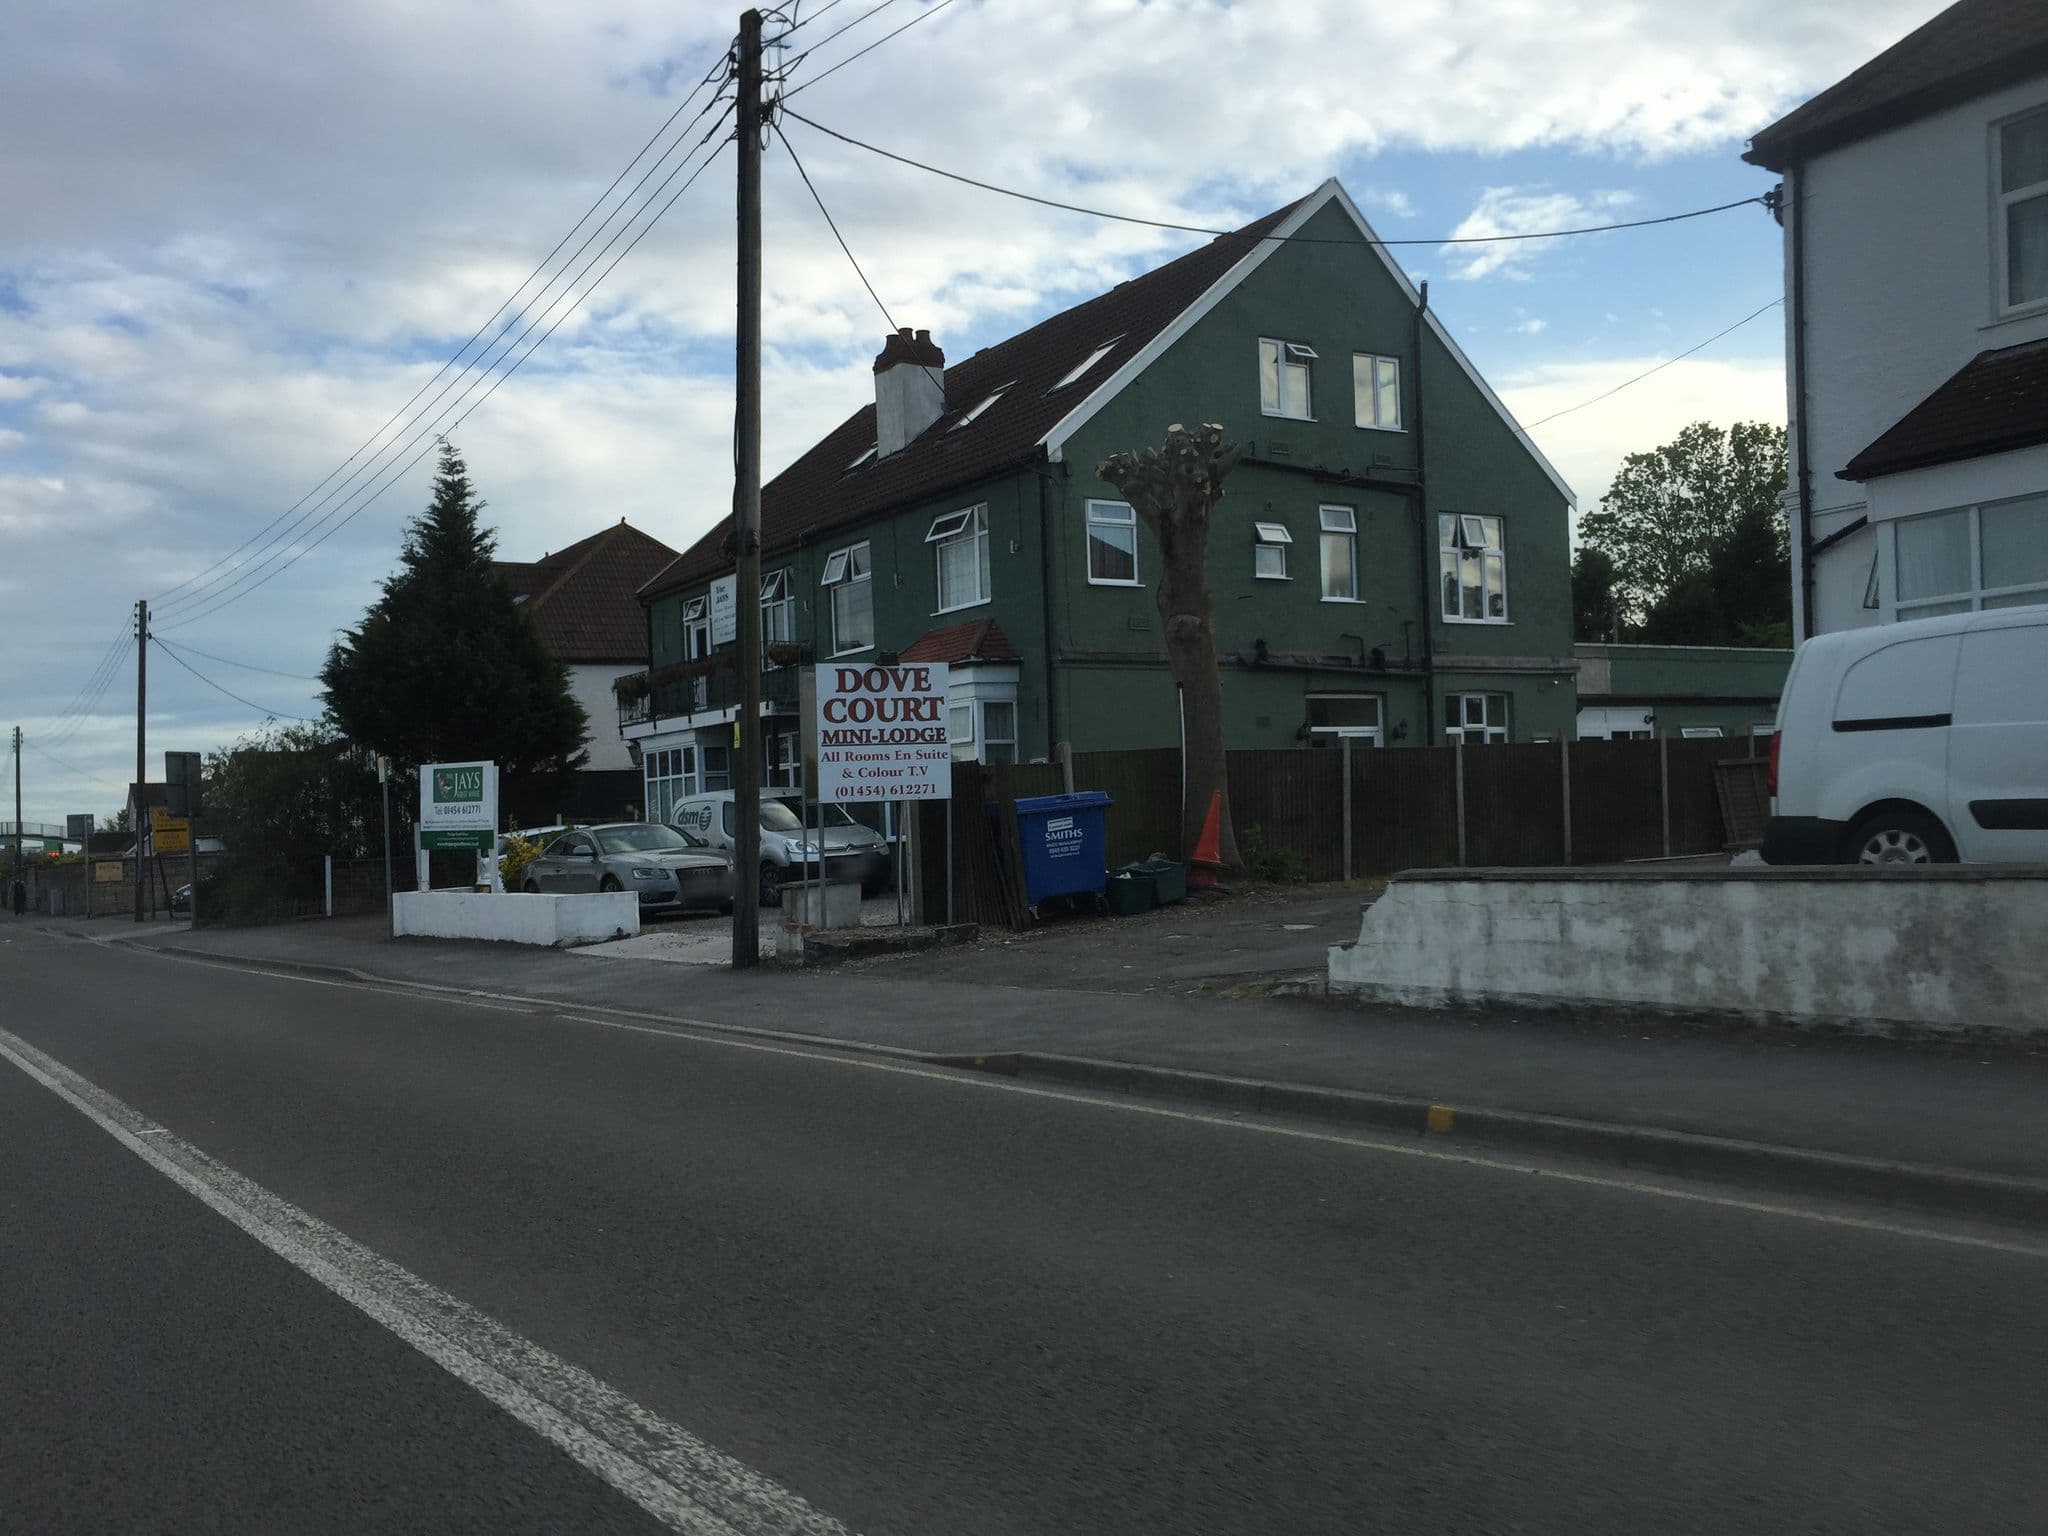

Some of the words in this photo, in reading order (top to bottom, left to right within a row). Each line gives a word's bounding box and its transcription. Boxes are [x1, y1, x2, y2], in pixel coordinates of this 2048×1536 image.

[834, 667, 932, 693] DOVE
[822, 696, 945, 723] COURT
[821, 727, 947, 745] MINI-LODGE
[821, 751, 839, 762] All
[845, 751, 890, 762] Rooms
[895, 750, 911, 760] En
[915, 749, 948, 760] Suite
[842, 767, 854, 778] &
[858, 766, 904, 778] Colour
[907, 765, 928, 776] T.V
[454, 771, 480, 798] JAYS
[835, 785, 886, 799] (01454)
[890, 784, 937, 795] 612271
[678, 808, 699, 825] dsm
[1045, 828, 1083, 841] SMITHS
